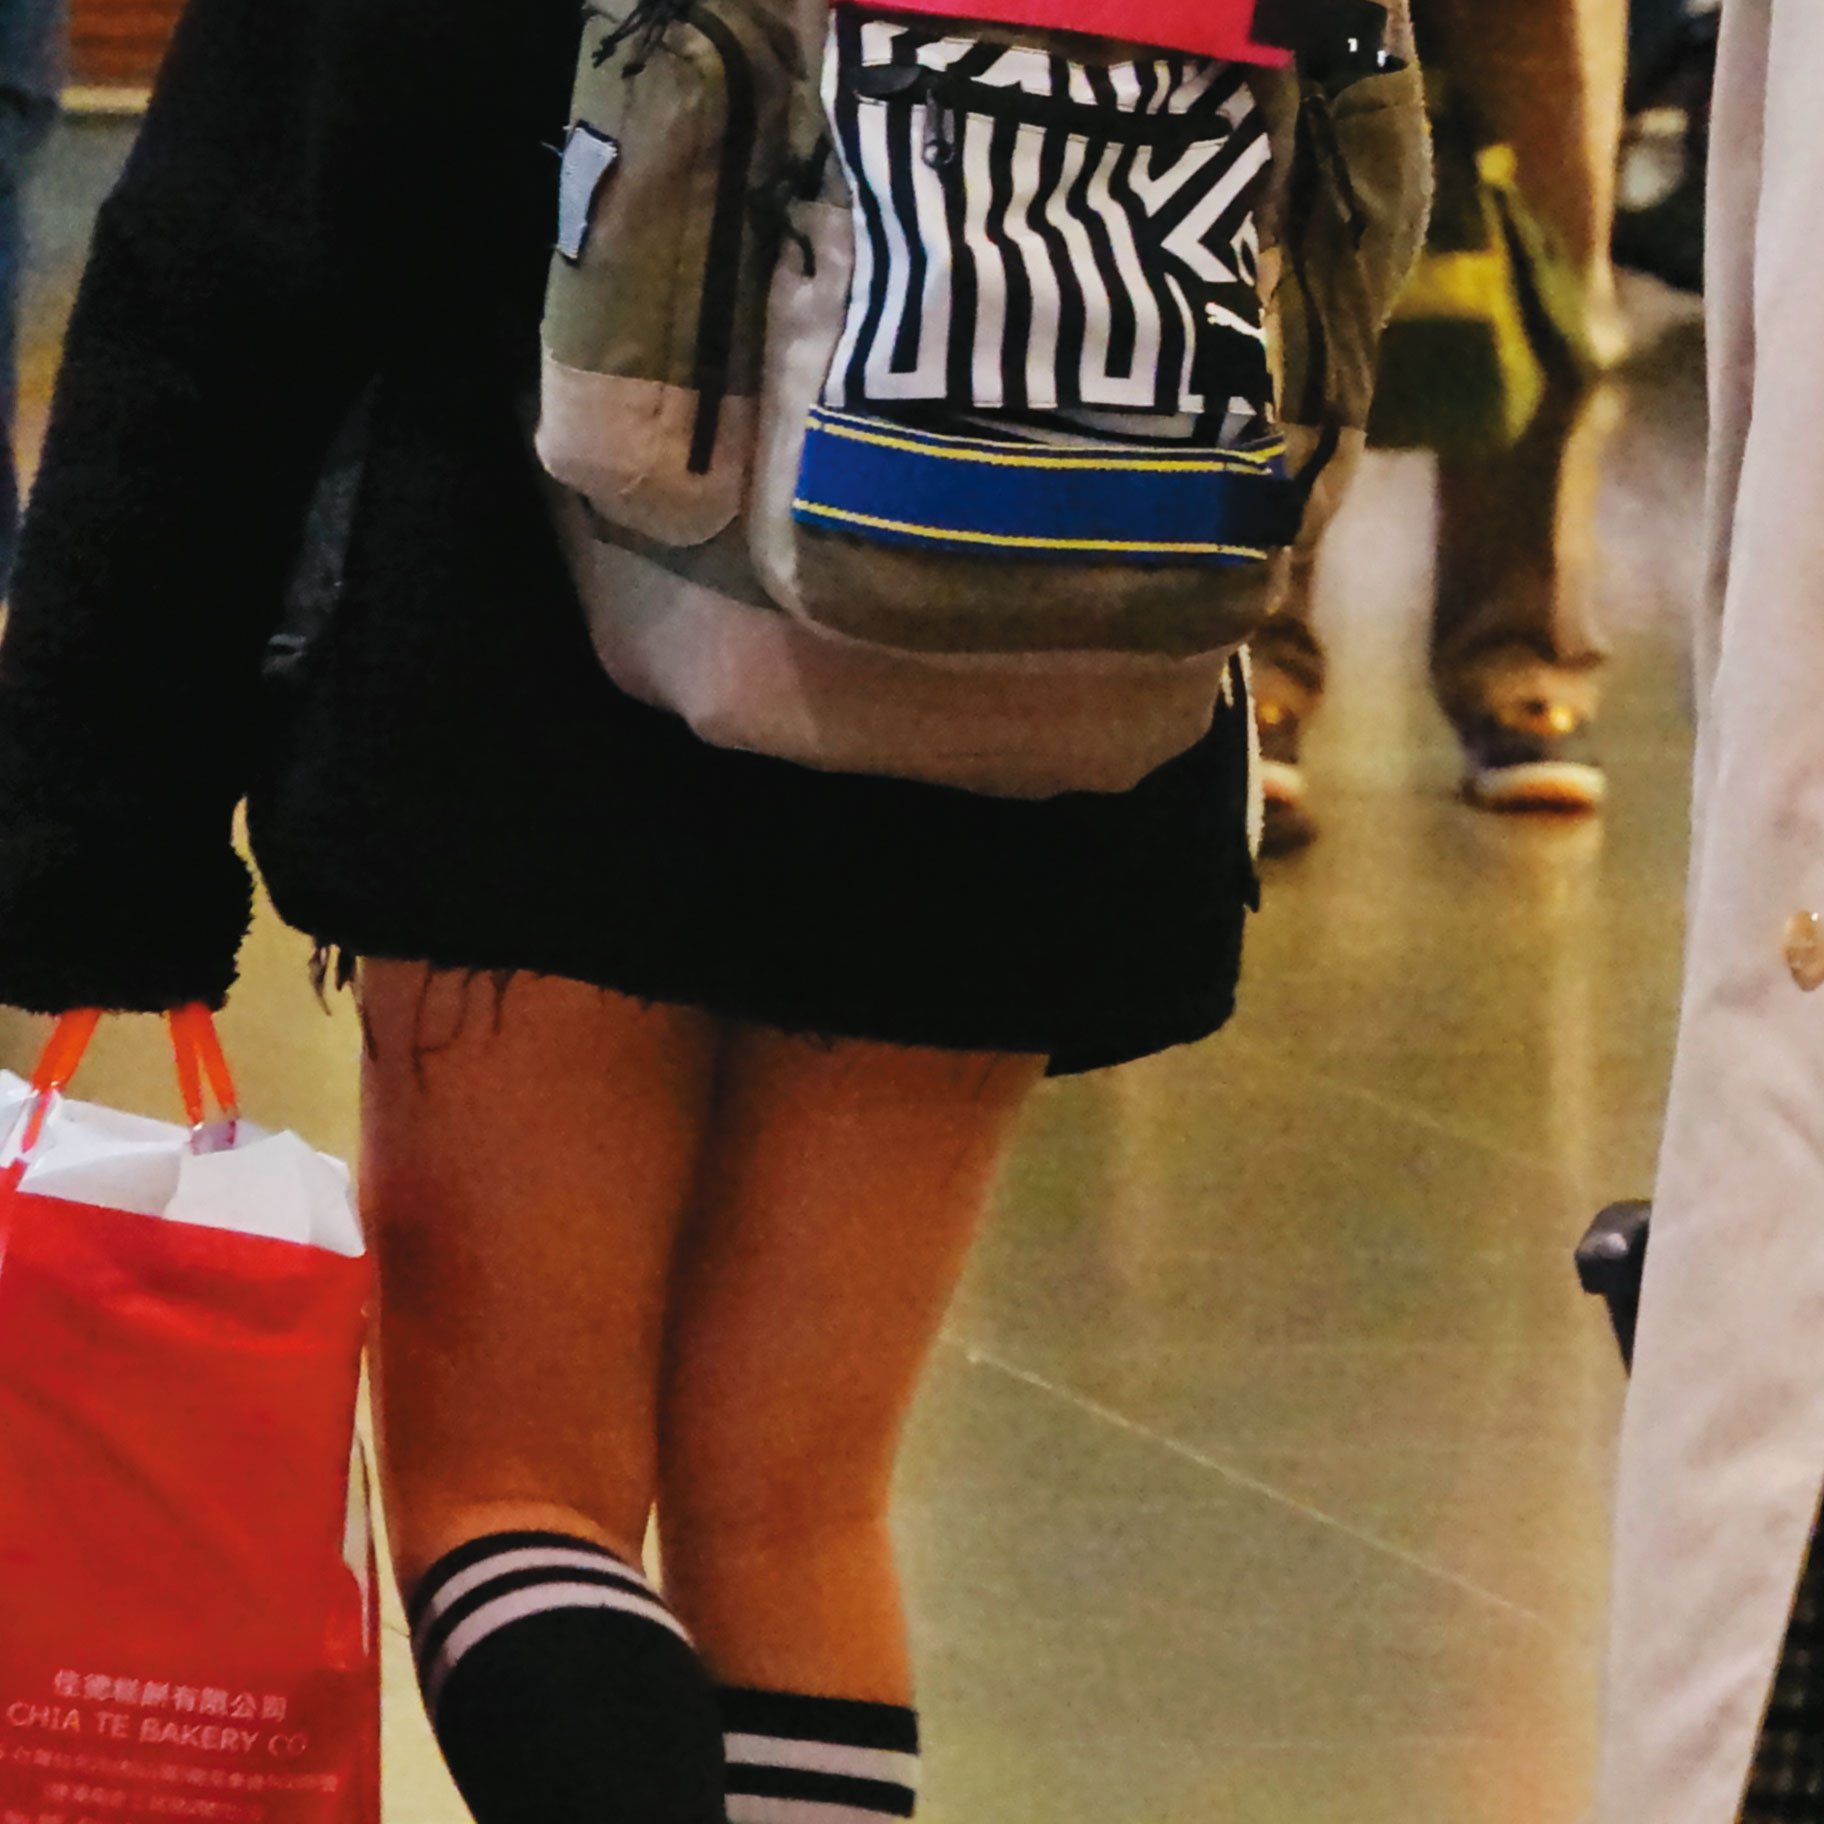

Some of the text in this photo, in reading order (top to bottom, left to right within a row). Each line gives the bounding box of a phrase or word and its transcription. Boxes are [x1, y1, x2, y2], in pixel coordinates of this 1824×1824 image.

[6, 1701, 81, 1734] CHIA
[95, 1711, 130, 1739] TE
[139, 1717, 259, 1753] BAKERY
